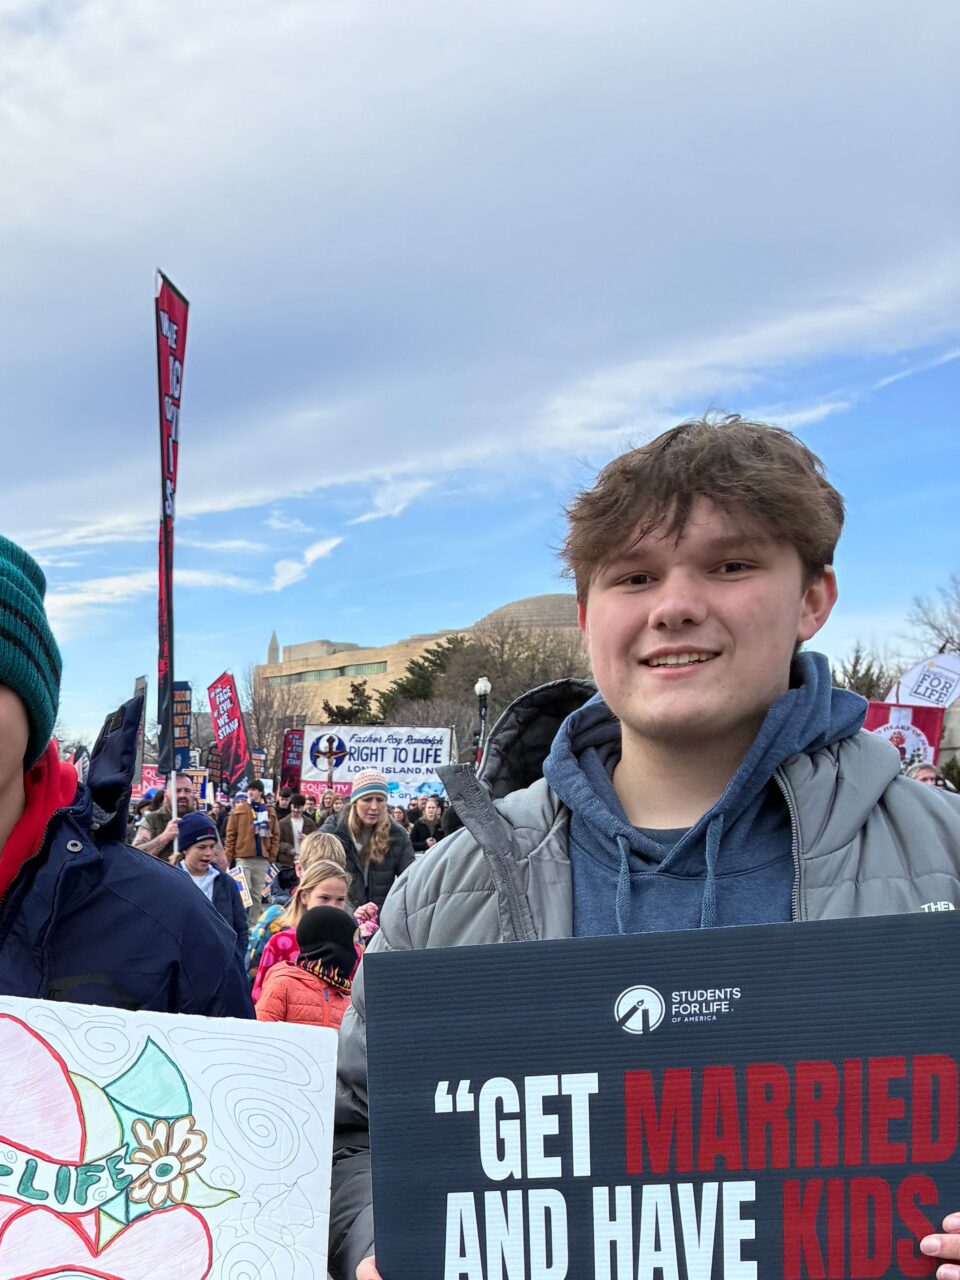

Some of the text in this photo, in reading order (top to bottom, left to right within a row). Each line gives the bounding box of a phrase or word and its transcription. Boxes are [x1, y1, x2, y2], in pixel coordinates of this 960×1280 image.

[920, 673, 952, 693] FOR
[914, 684, 947, 703] LIFE
[217, 712, 230, 727] WE
[218, 718, 239, 739] STAND
[348, 746, 442, 764] RIGHT TO LIFE
[301, 783, 349, 793] EQUAITY
[672, 988, 742, 1003] STUDENTS
[672, 1003, 700, 1015] FOR
[623, 1054, 958, 1175] MARRIED
[783, 1174, 937, 1280] KIDS
